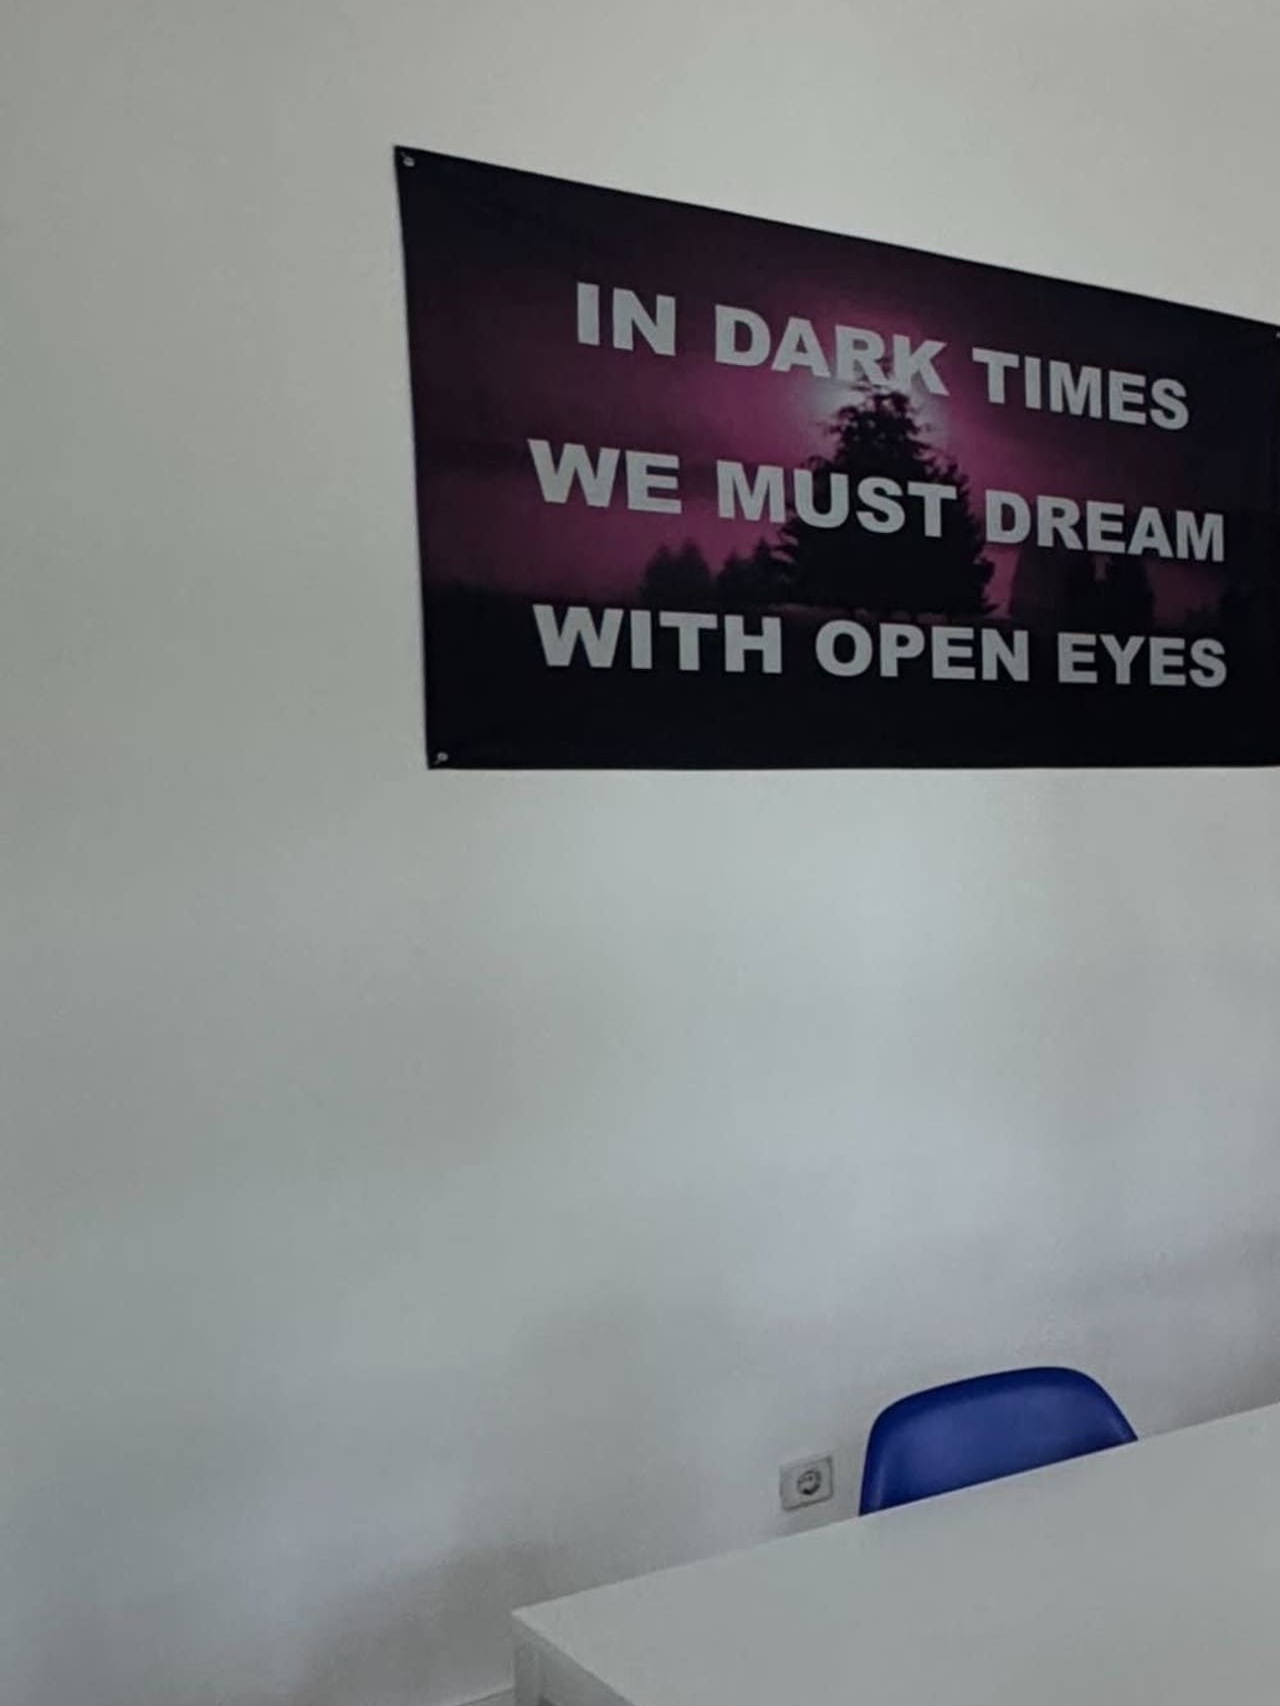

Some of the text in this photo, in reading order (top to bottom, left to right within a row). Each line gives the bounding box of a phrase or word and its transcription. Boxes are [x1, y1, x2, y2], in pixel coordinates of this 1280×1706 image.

[576, 282, 1190, 430] IN DARK TIMES
[528, 439, 1224, 562] WE MUST DREAM
[533, 605, 1228, 688] WITH OPEN EYES
